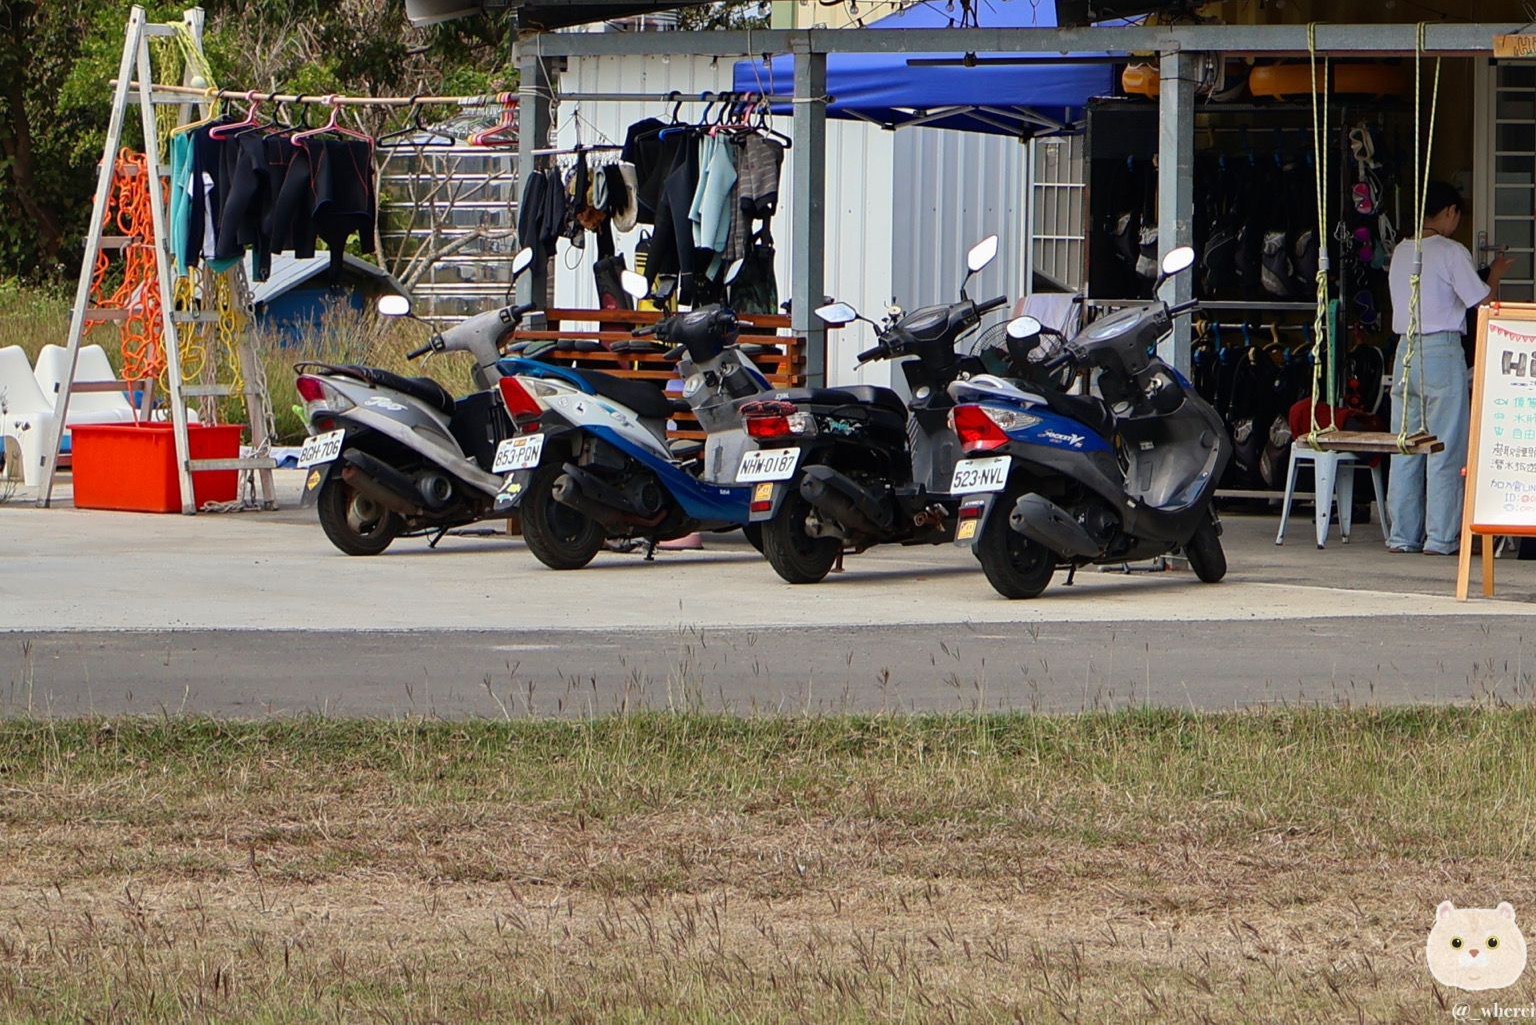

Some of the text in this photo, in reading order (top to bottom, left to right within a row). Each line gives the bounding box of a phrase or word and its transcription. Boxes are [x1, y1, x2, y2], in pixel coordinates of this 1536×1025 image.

[300, 440, 340, 462] BGH-706
[495, 445, 540, 467] 853-PQN
[740, 456, 795, 475] NHW-0187
[953, 467, 1004, 488] 523-NVL
